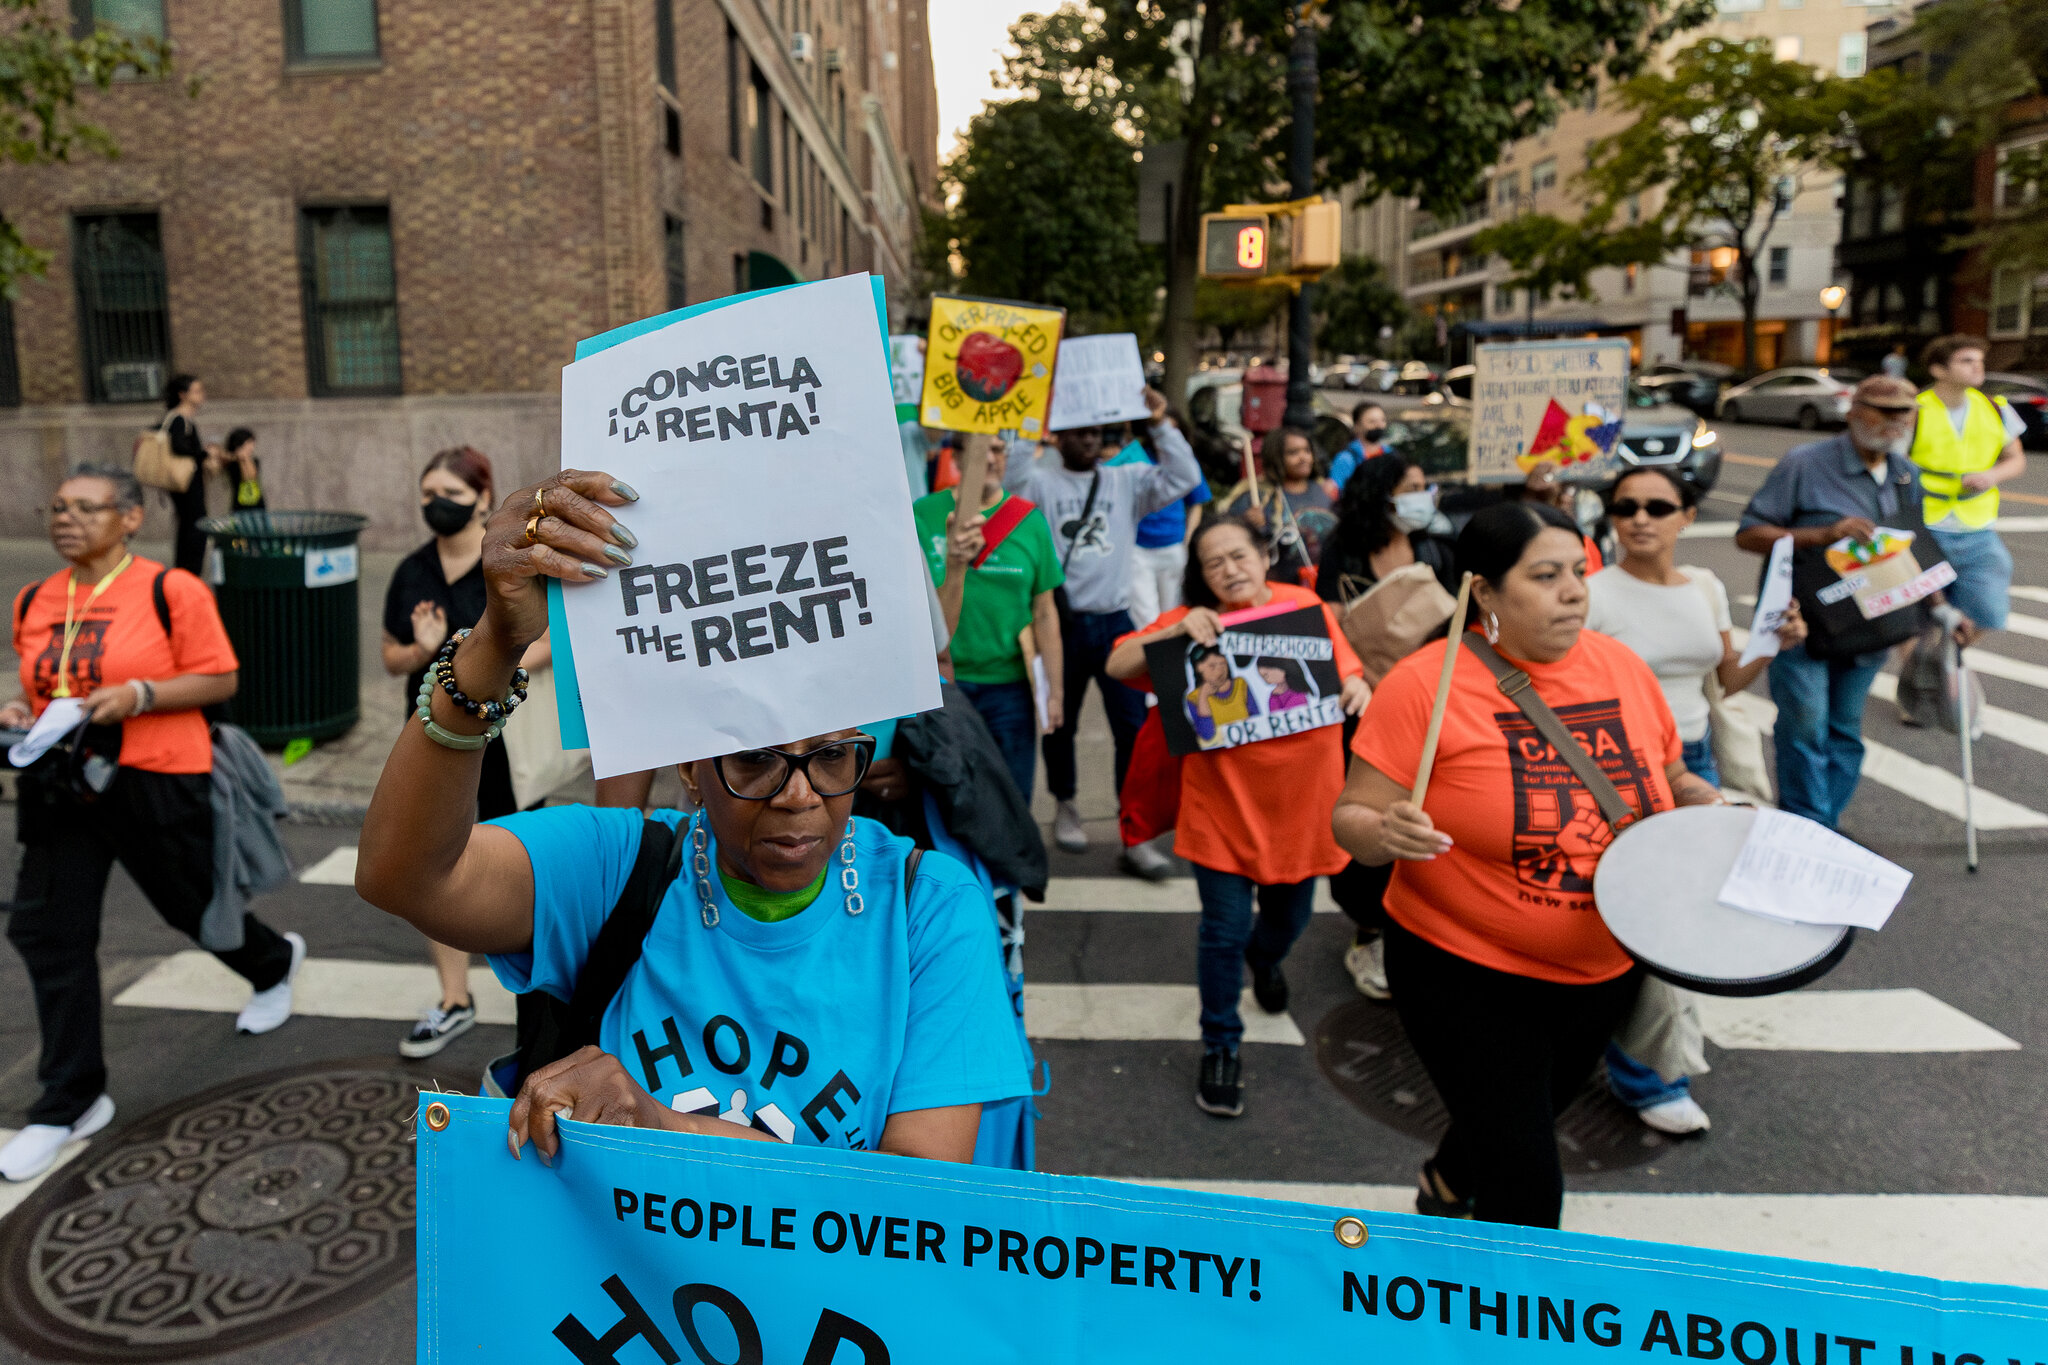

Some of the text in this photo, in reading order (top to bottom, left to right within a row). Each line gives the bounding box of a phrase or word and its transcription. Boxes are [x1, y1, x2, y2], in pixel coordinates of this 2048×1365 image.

[656, 392, 820, 442] RENTA!
[934, 372, 1033, 425] BIG APPLE
[618, 536, 855, 616] FREEZE
[616, 577, 873, 667] THE RENT!
[1227, 722, 1261, 745] OR
[1518, 890, 1560, 908] new
[632, 1015, 861, 1144] HOPE
[613, 1187, 1262, 1302] PEOPLE OVER PROPERTY!
[1342, 1270, 1876, 1365] NOTHING ABOUT
